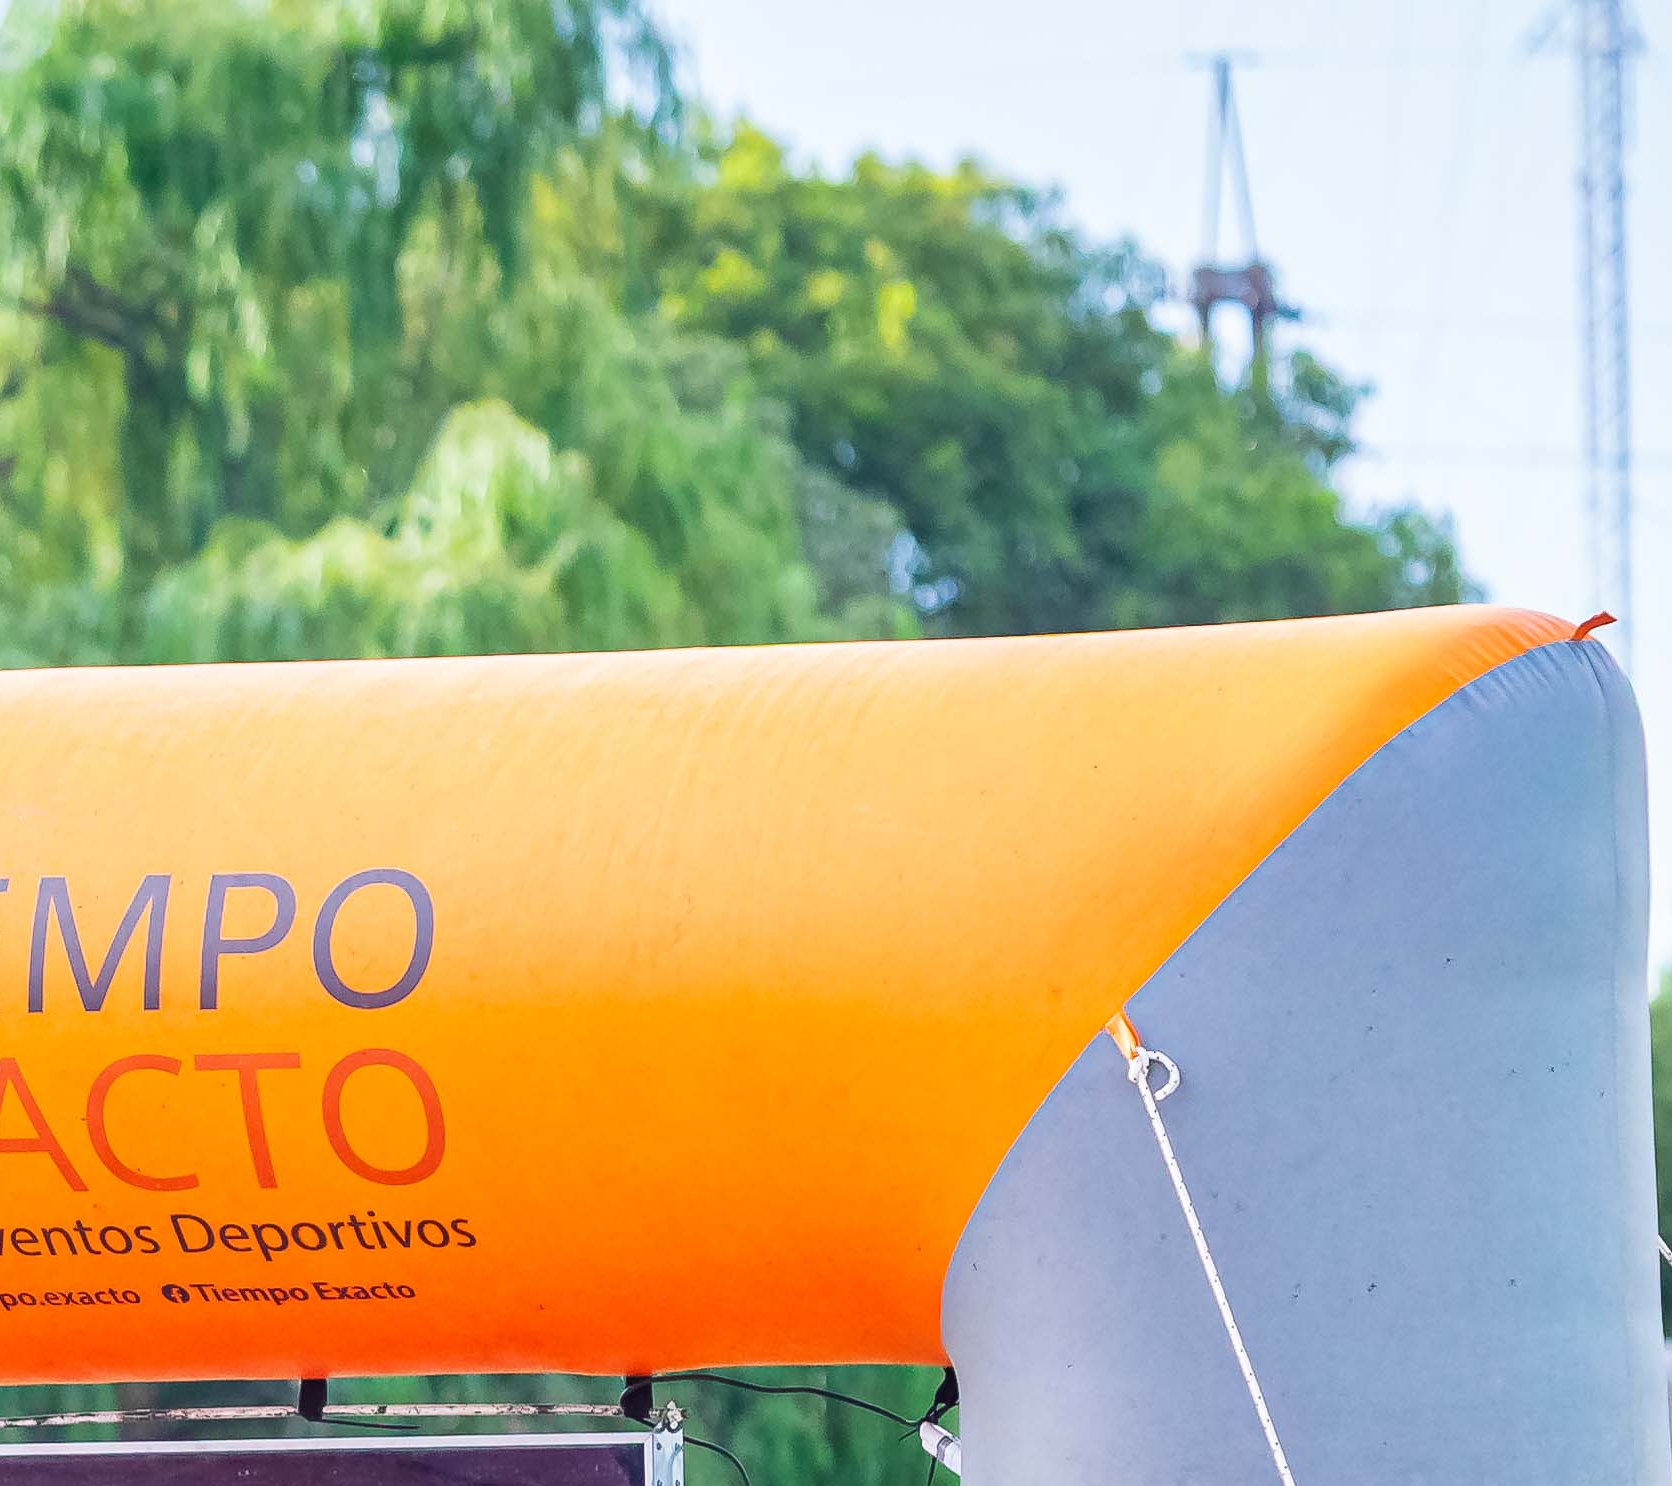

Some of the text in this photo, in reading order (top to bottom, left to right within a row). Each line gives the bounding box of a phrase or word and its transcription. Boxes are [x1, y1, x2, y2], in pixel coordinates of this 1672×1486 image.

[177, 1210, 478, 1262] Deportivos
[190, 1282, 310, 1306] Tiempo
[311, 1281, 417, 1302] Exacto
